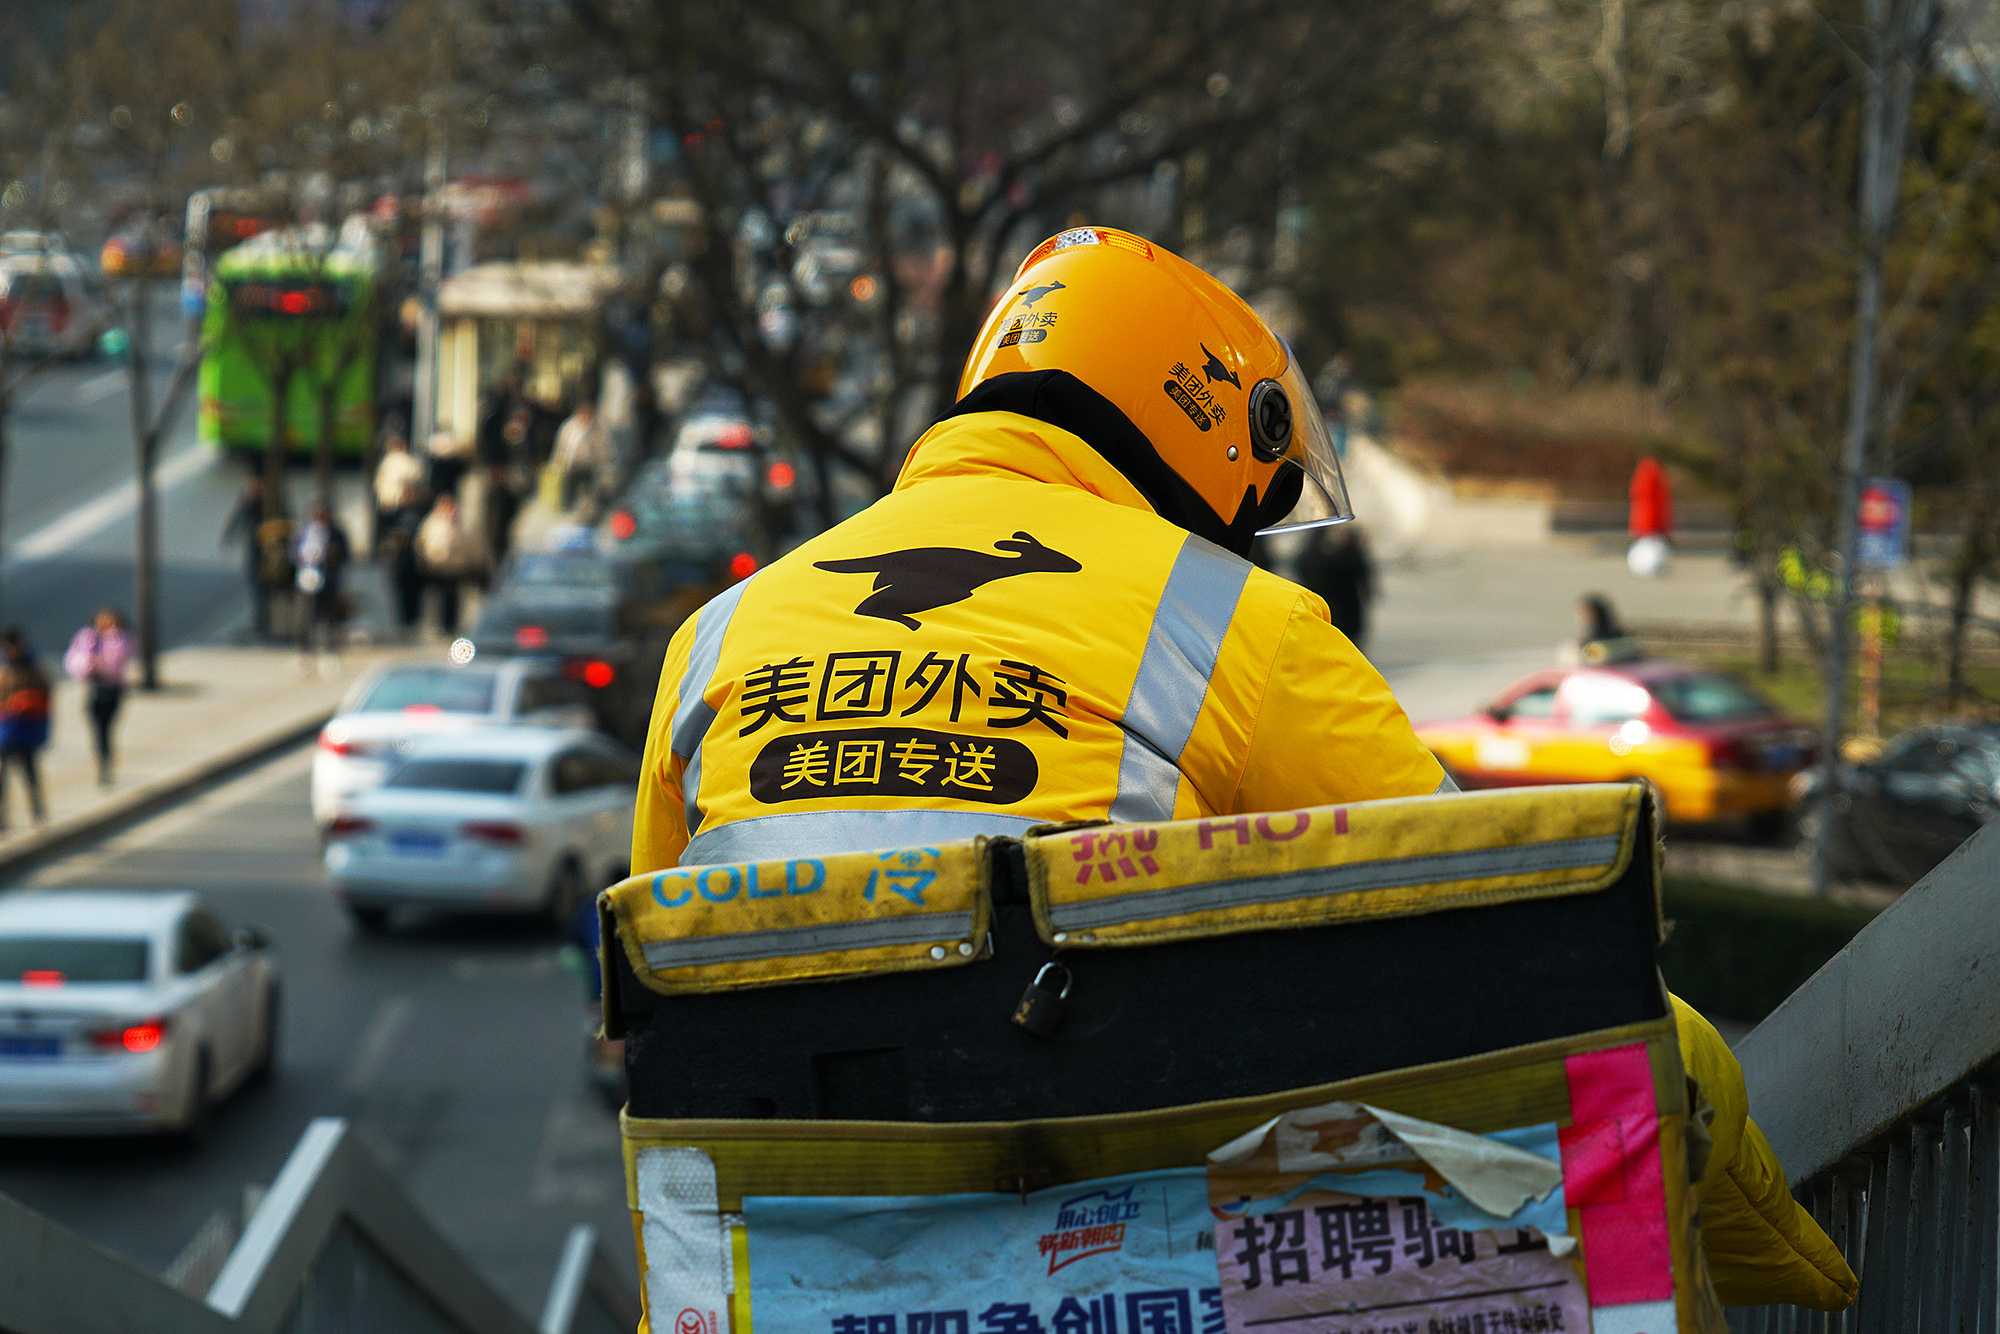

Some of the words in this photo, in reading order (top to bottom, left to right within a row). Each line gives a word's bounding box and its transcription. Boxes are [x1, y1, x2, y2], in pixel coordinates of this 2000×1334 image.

[1168, 361, 1227, 427] 美团外卖
[1168, 385, 1207, 427] 美团专送
[738, 650, 1070, 740] 美团外卖
[780, 738, 996, 791] 美团专送
[651, 857, 827, 909] COLD
[862, 846, 942, 907] 冷
